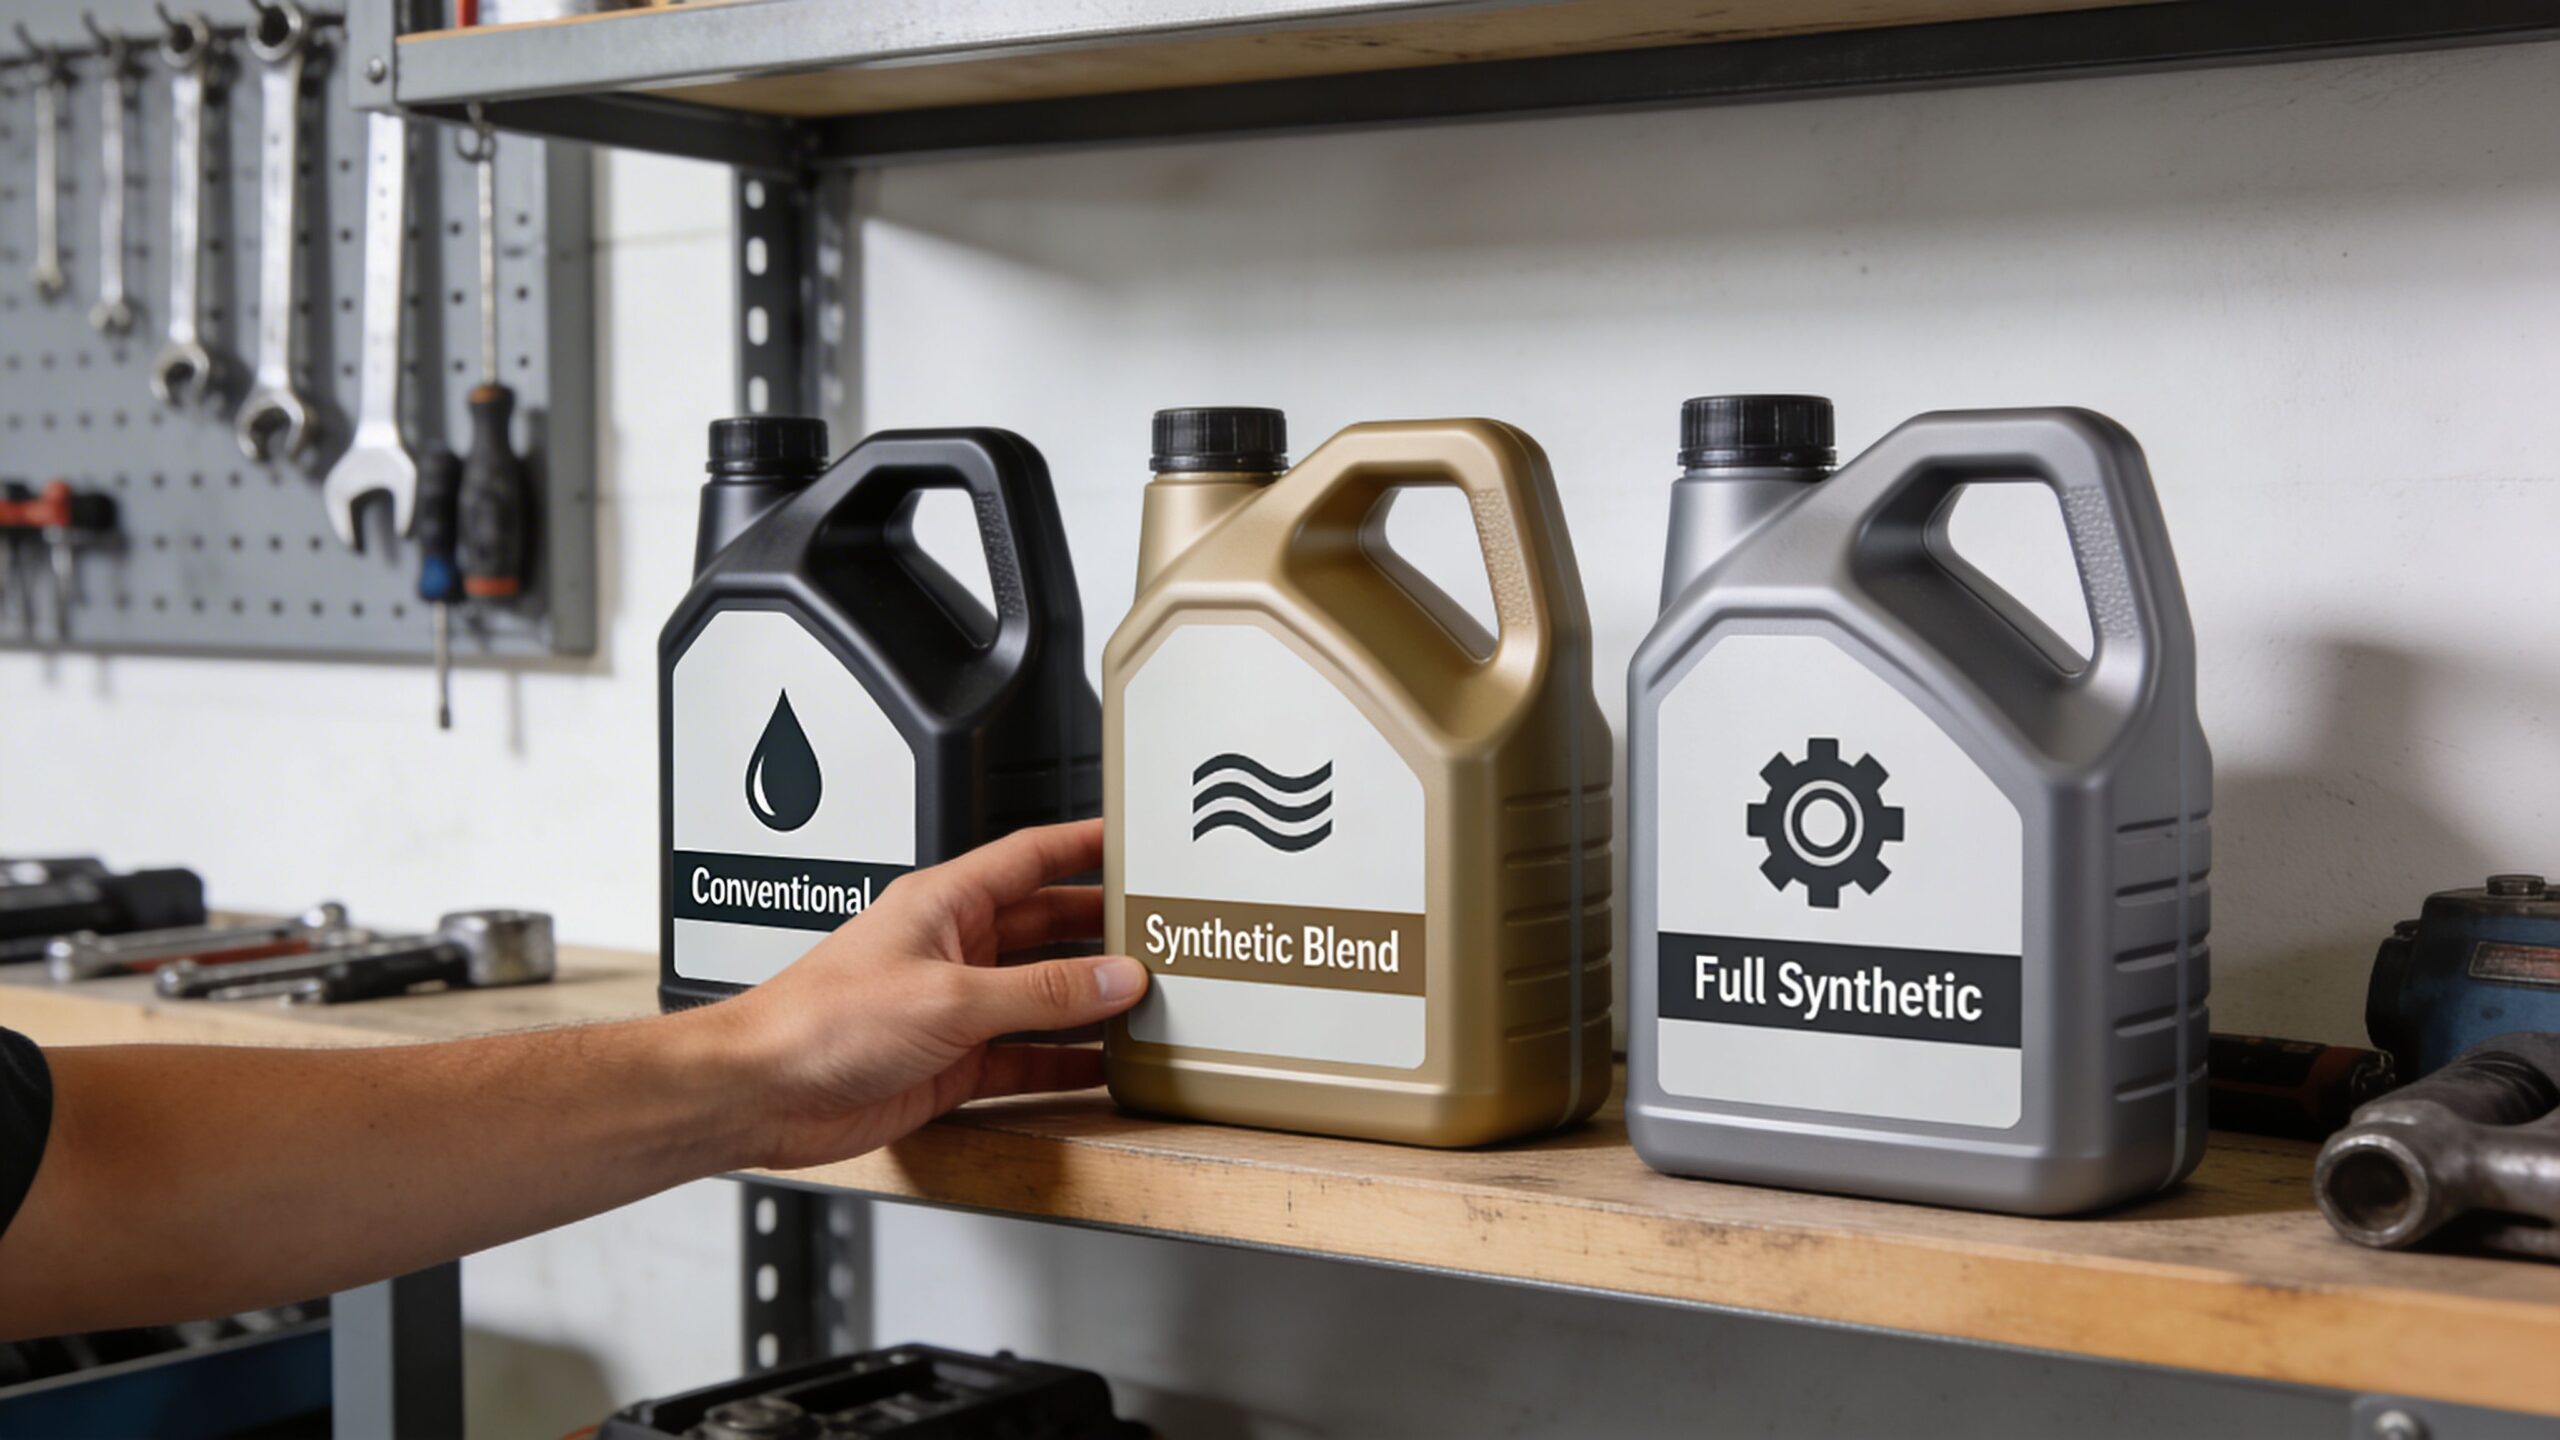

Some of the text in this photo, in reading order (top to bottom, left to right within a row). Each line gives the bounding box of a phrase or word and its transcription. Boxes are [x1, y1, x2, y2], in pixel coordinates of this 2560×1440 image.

[691, 866, 871, 915] Conventional
[1145, 913, 1399, 974] Synthetic Blend
[1695, 954, 1983, 1021] Full Synthetic
